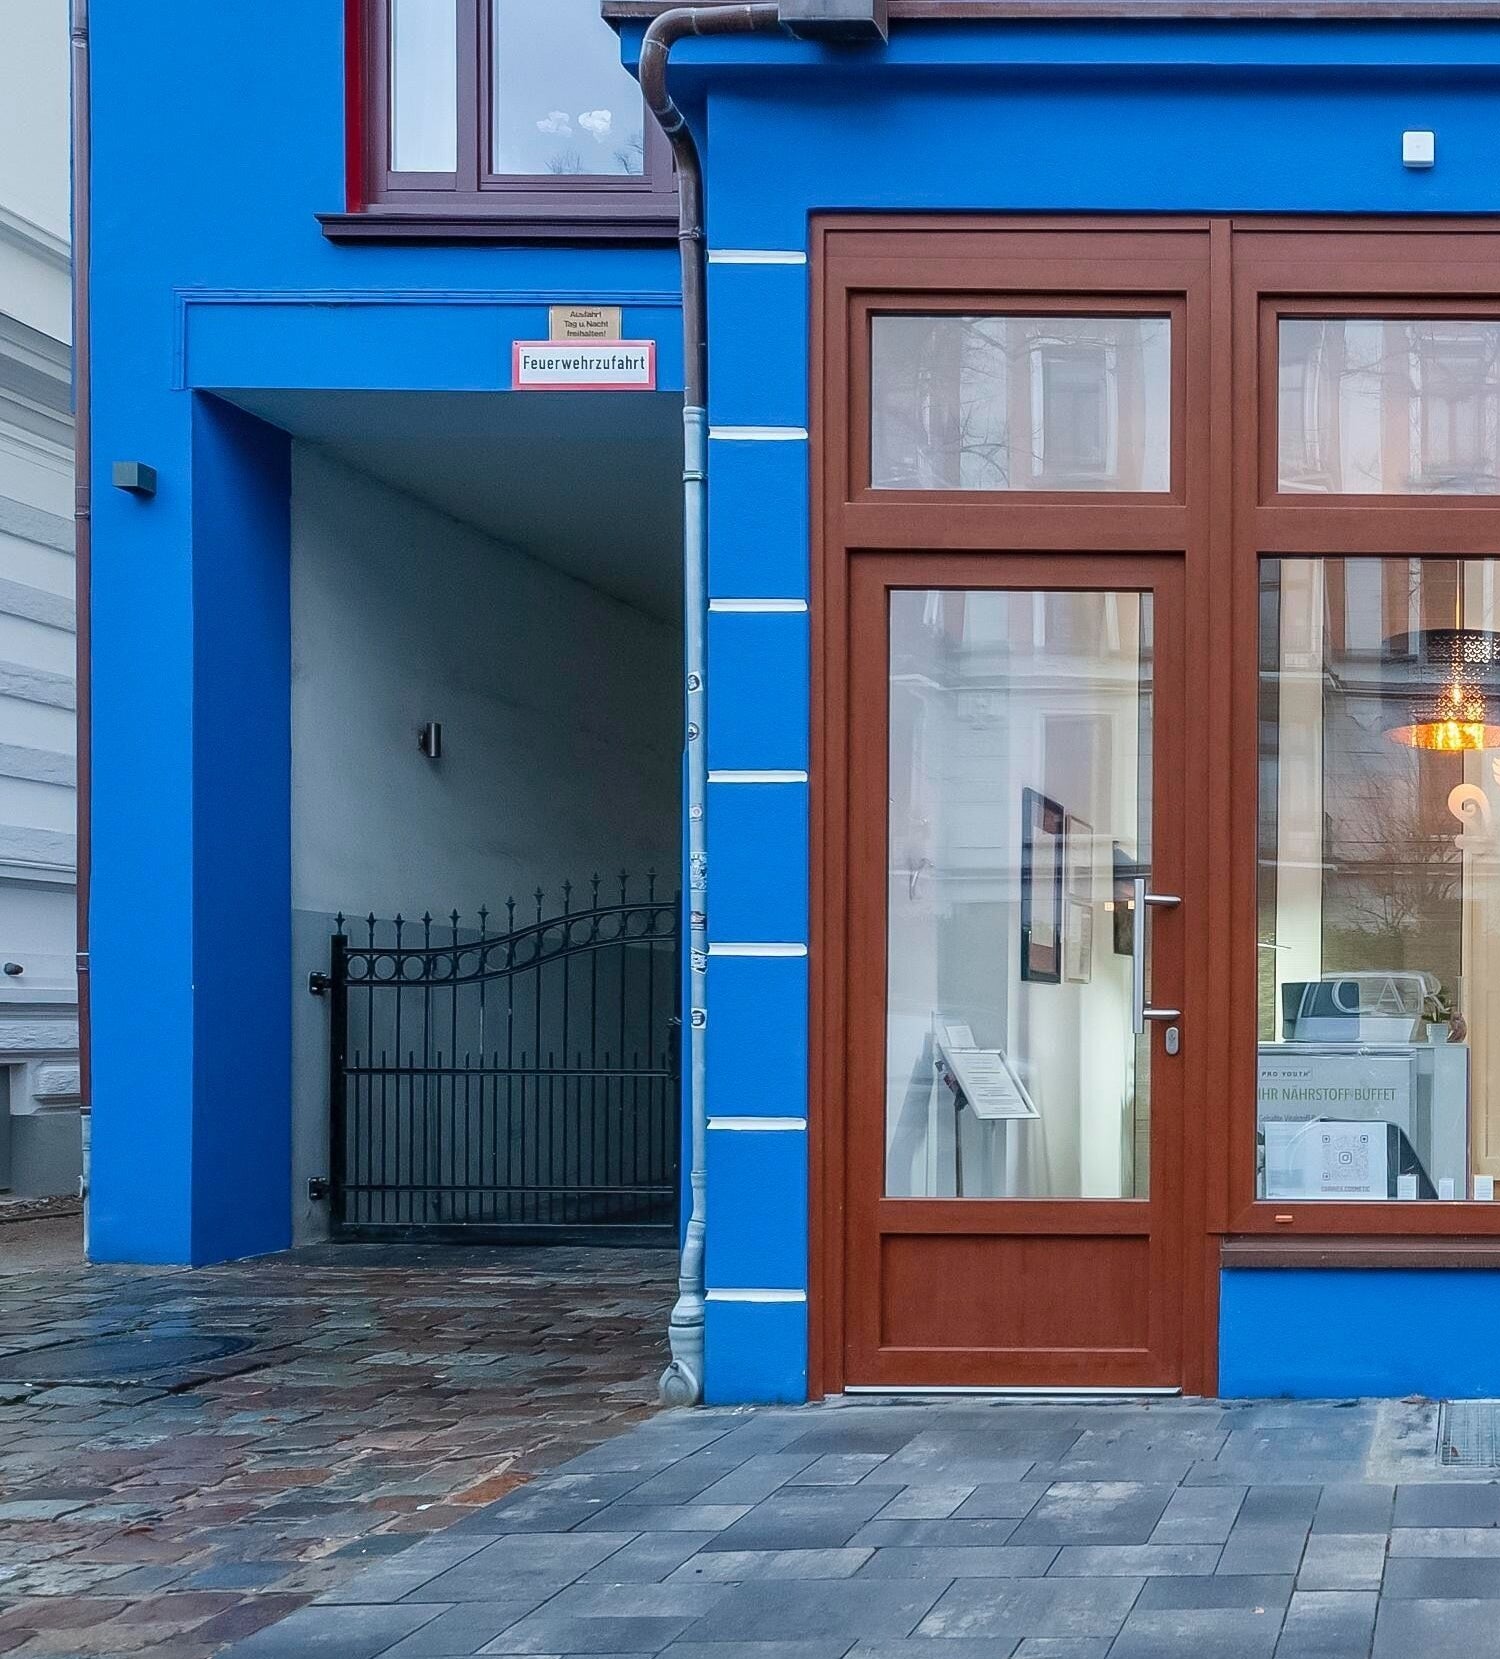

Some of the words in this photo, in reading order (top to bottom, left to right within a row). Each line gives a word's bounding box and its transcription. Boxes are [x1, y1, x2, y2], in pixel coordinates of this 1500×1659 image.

[570, 310, 602, 318] Ausfahrt
[564, 320, 578, 328] Tag
[586, 320, 609, 328] Nacht
[523, 355, 646, 370] Feuerwehrzufahrt
[1258, 1087, 1278, 1101] IHR
